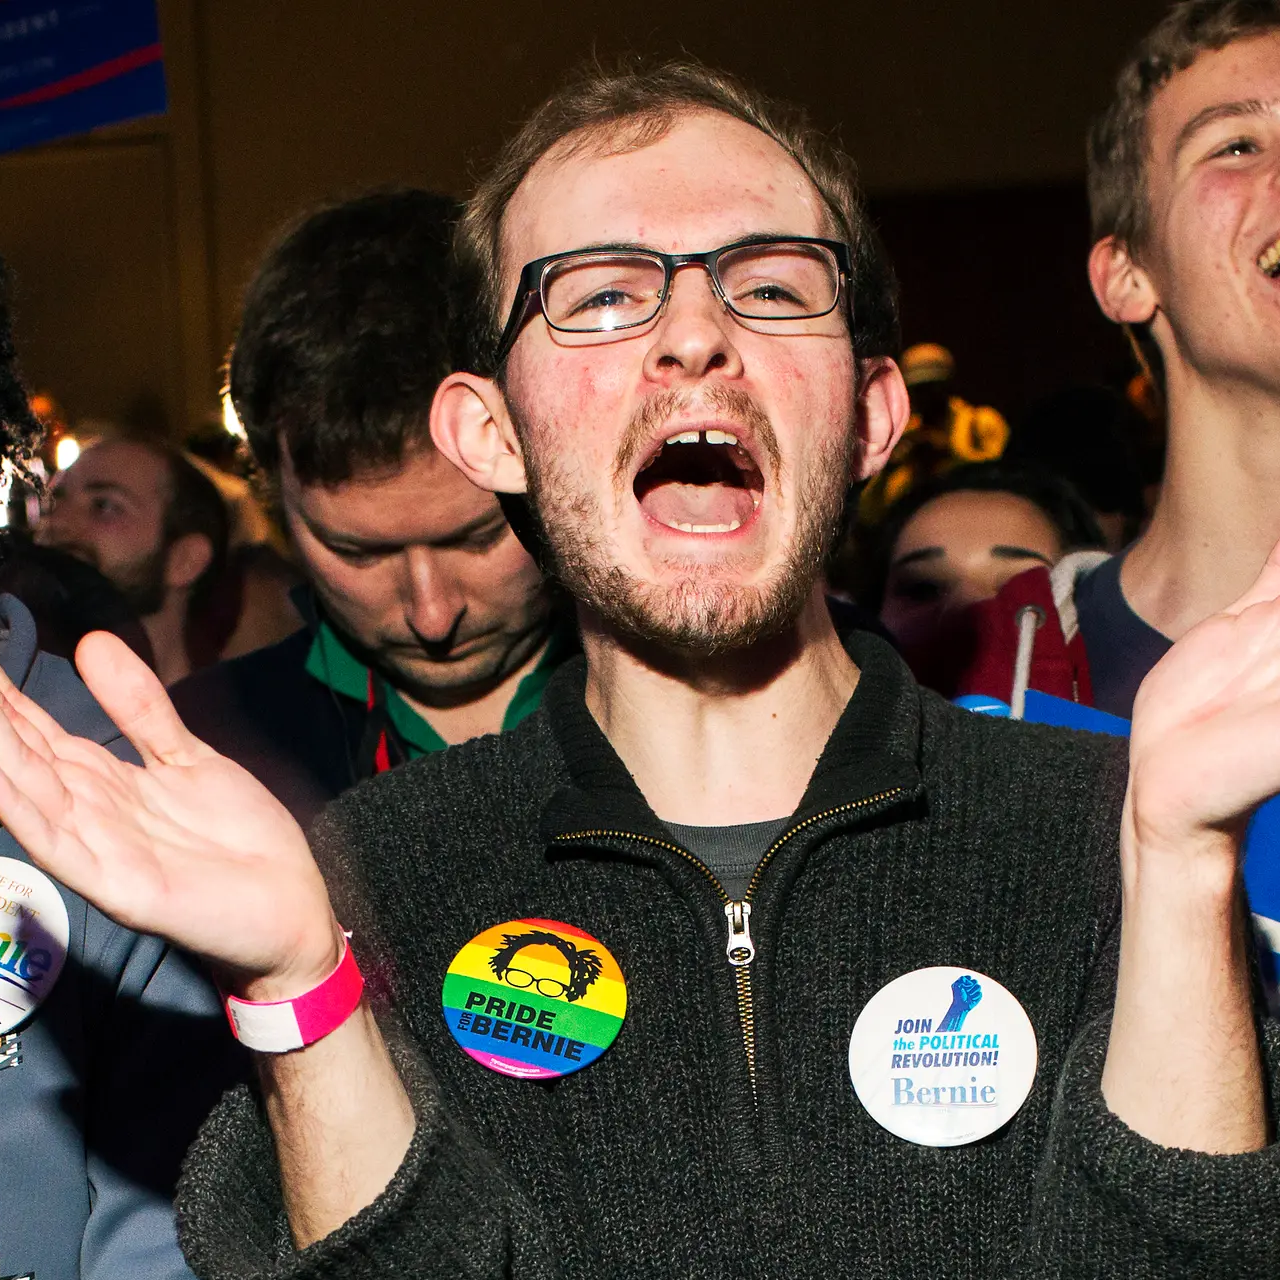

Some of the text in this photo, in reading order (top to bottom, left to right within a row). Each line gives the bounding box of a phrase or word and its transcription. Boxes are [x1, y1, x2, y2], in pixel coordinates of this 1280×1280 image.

[8, 880, 34, 899] FOR
[464, 991, 557, 1031] PRIDE
[894, 1018, 933, 1035] JOIN
[457, 1012, 585, 1062] FOR BERNIE
[892, 1034, 1000, 1051] the POLITICAL
[891, 1050, 999, 1069] REVOLUTION!
[891, 1076, 996, 1106] Bernie
